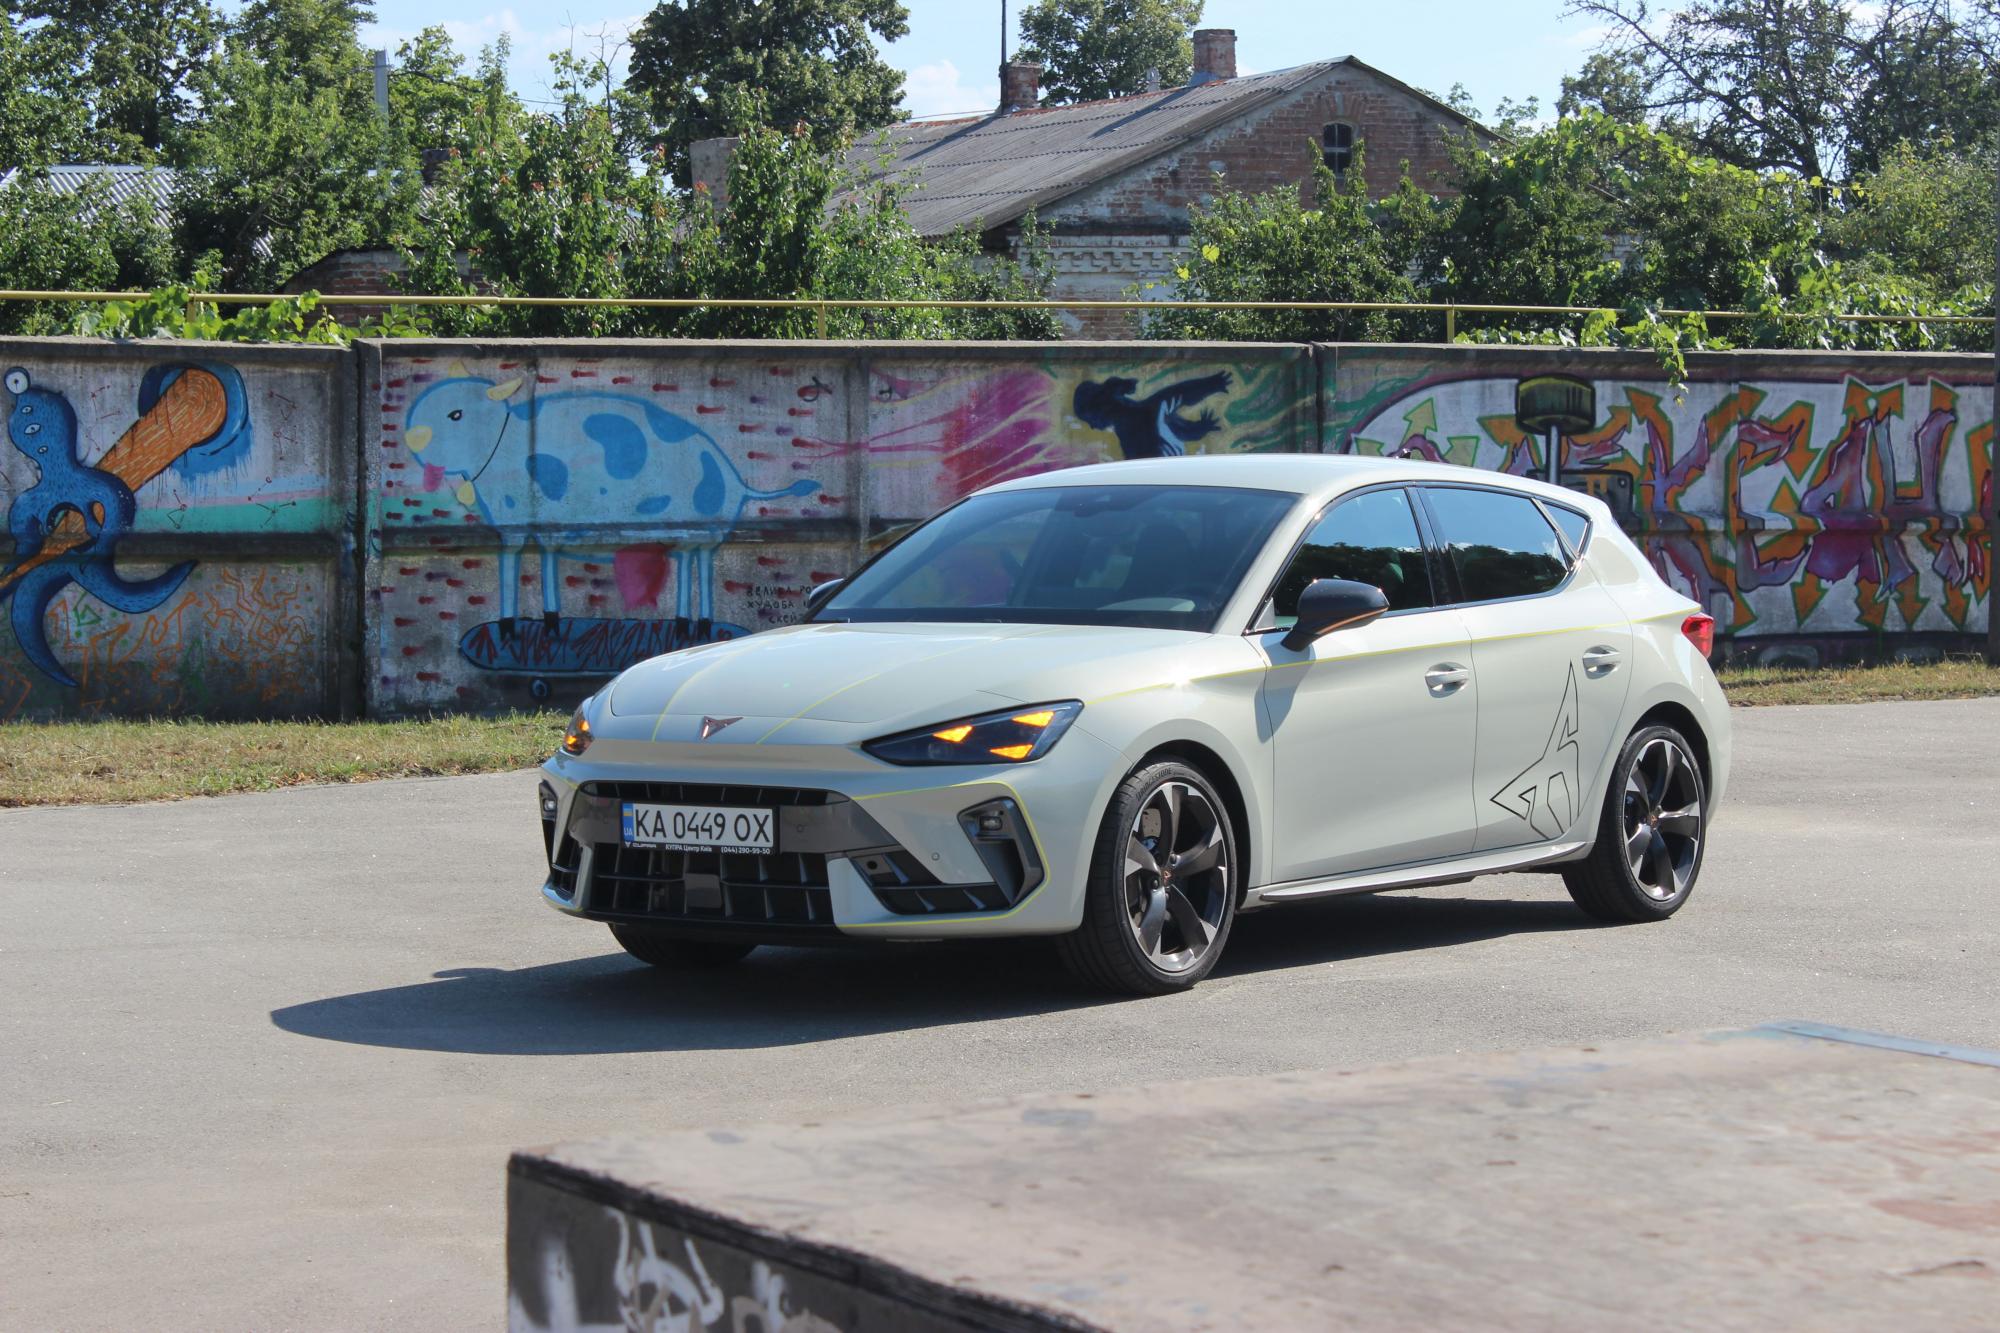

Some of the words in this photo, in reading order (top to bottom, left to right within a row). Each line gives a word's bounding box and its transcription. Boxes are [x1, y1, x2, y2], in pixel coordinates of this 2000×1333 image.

[635, 809, 667, 838] KA
[673, 811, 726, 840] 0449
[734, 813, 770, 842] OX
[623, 827, 633, 836] UA
[683, 844, 700, 852] Центр
[721, 846, 737, 854] (044)
